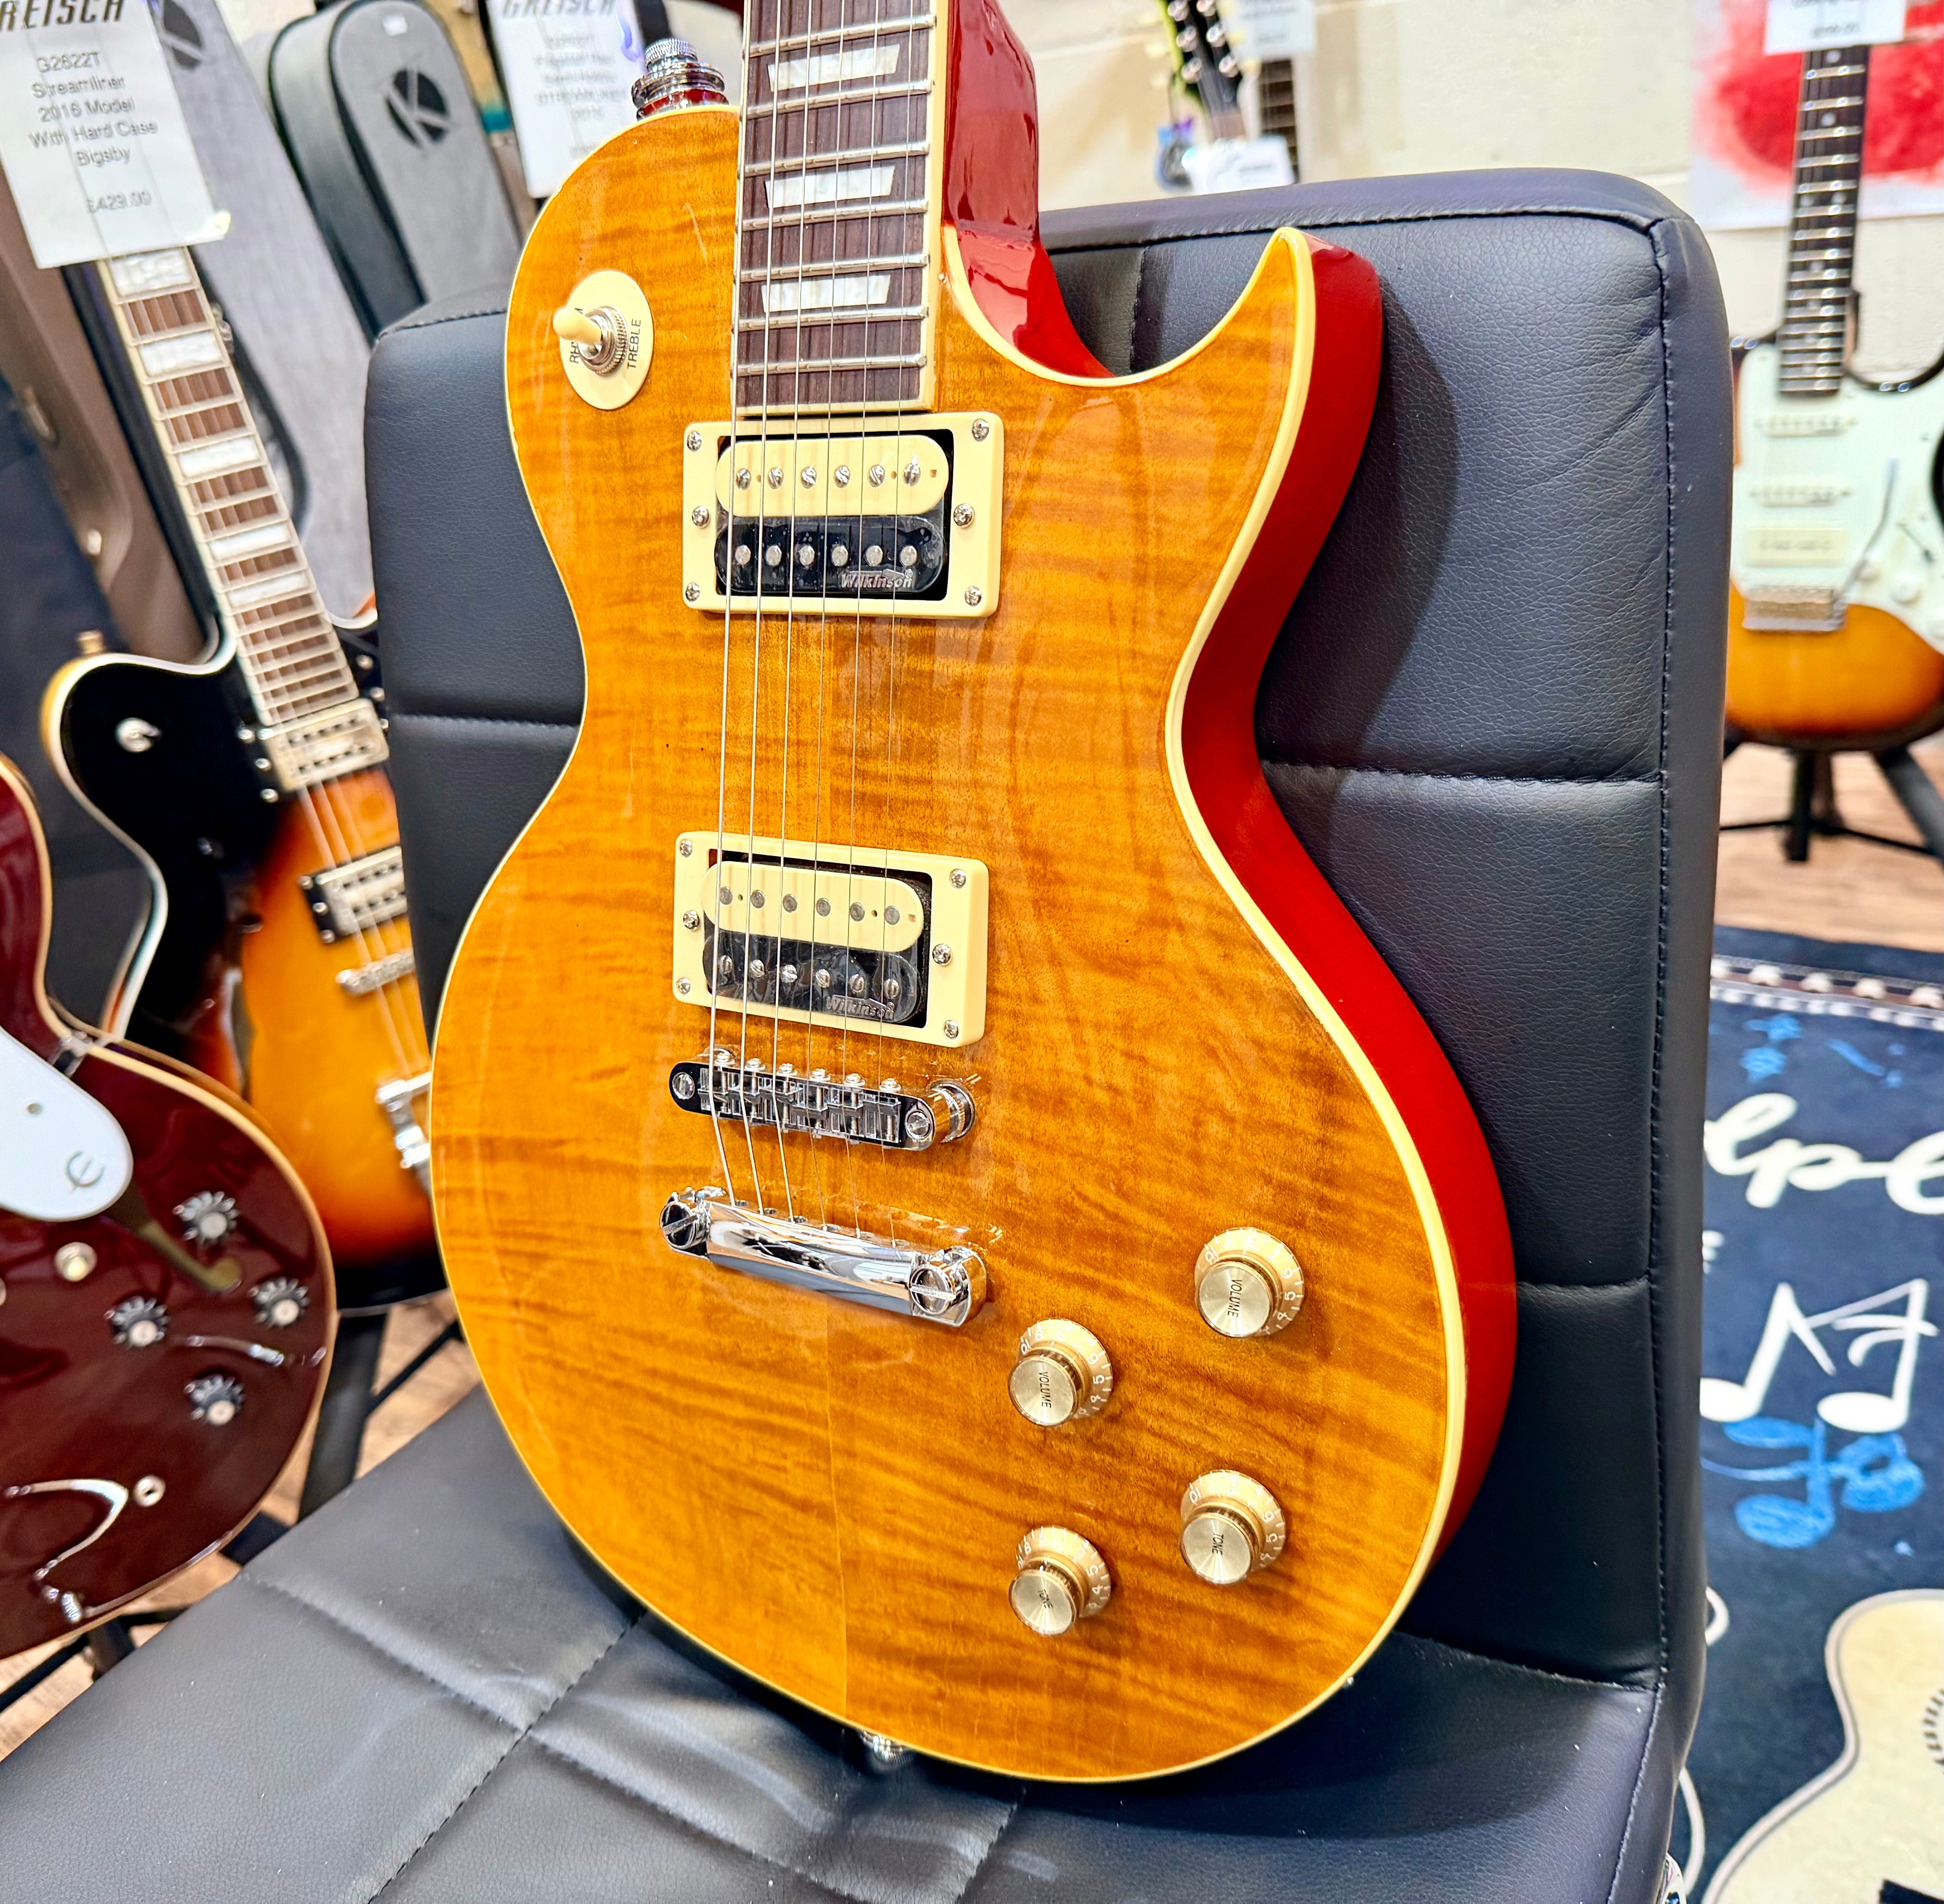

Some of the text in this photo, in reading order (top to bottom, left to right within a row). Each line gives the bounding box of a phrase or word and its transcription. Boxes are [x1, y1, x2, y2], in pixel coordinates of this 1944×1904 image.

[36, 51, 101, 73] G2622T
[31, 75, 126, 99] Streamliner
[38, 96, 136, 123] 2016 Model
[28, 120, 159, 149] With Hard Case
[74, 144, 131, 168] Bigsby
[627, 318, 641, 370] TREBLE
[841, 574, 913, 588] Wilkinson
[826, 996, 894, 1020] Wilkinson
[1227, 1279, 1242, 1318] VOLUME
[1038, 1372, 1051, 1409] VOLUME
[1212, 1533, 1224, 1556] TONE
